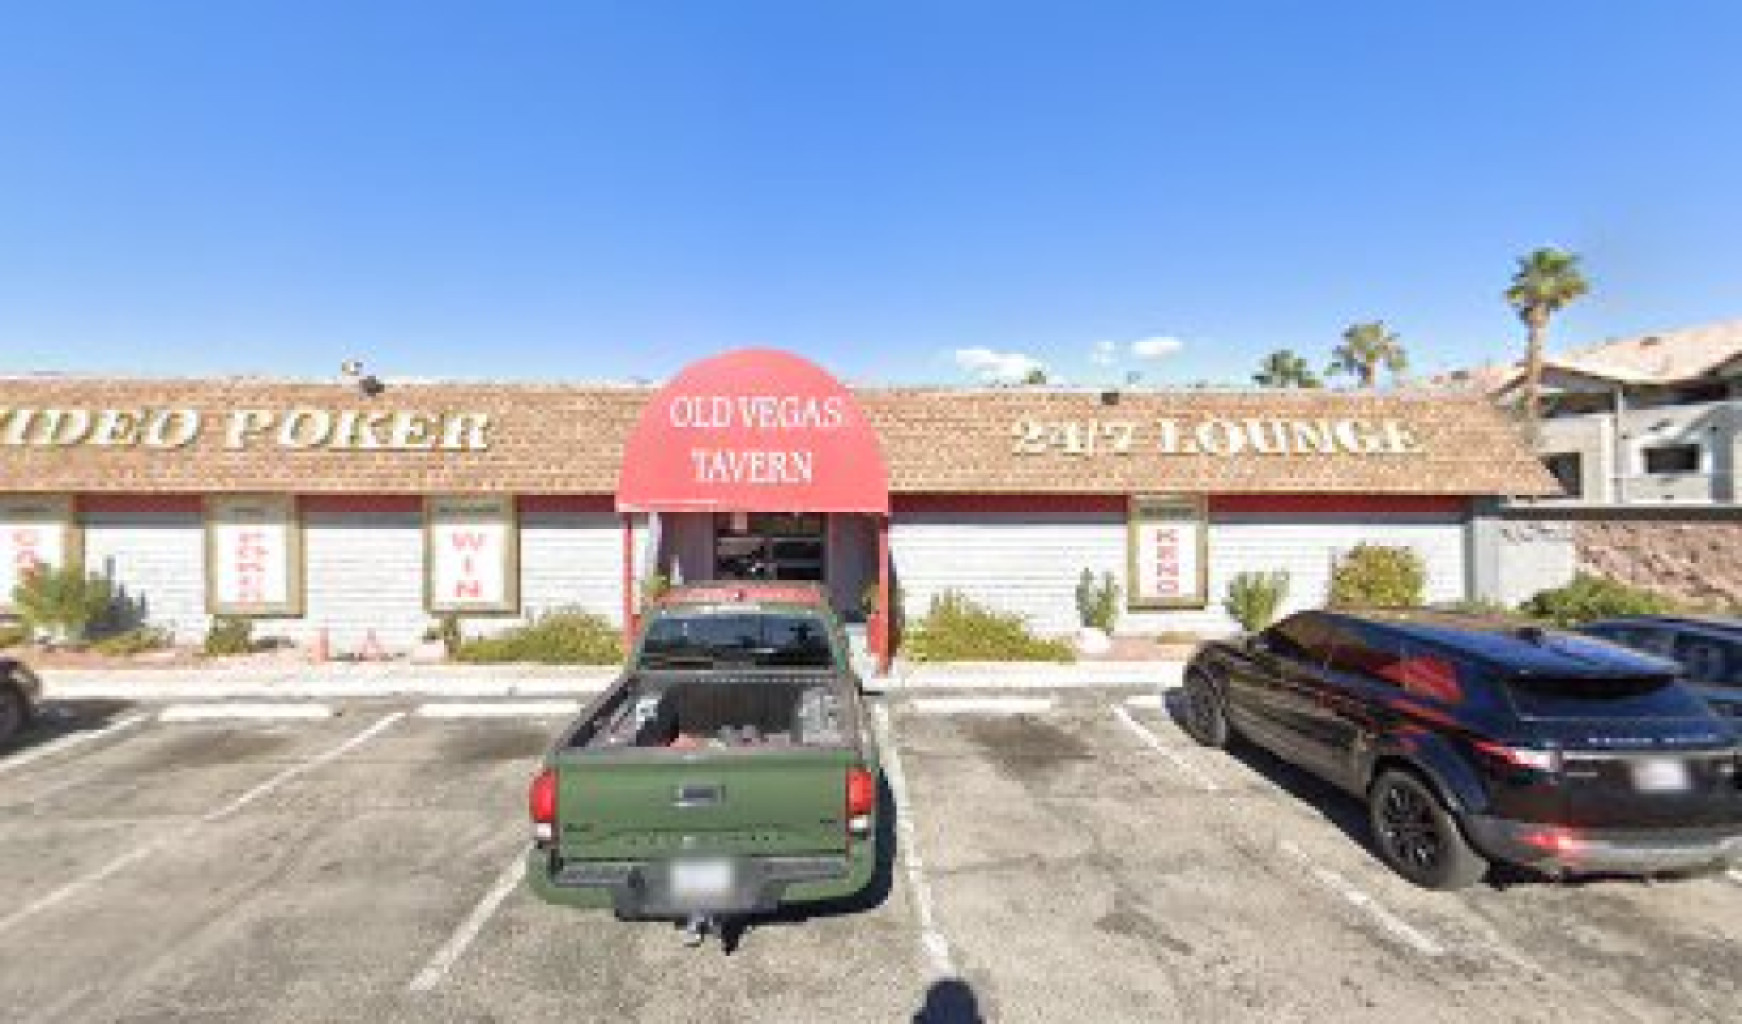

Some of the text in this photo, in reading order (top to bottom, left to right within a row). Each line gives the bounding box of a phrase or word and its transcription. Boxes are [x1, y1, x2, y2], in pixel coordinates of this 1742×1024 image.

[0, 408, 491, 450] IDEO POKER
[669, 396, 843, 427] OLD VEGAS
[1012, 417, 1424, 455] 24/7 LOUNGE
[691, 448, 813, 483] TAVERN
[450, 530, 485, 599] WIN
[1155, 528, 1180, 594] KENO
